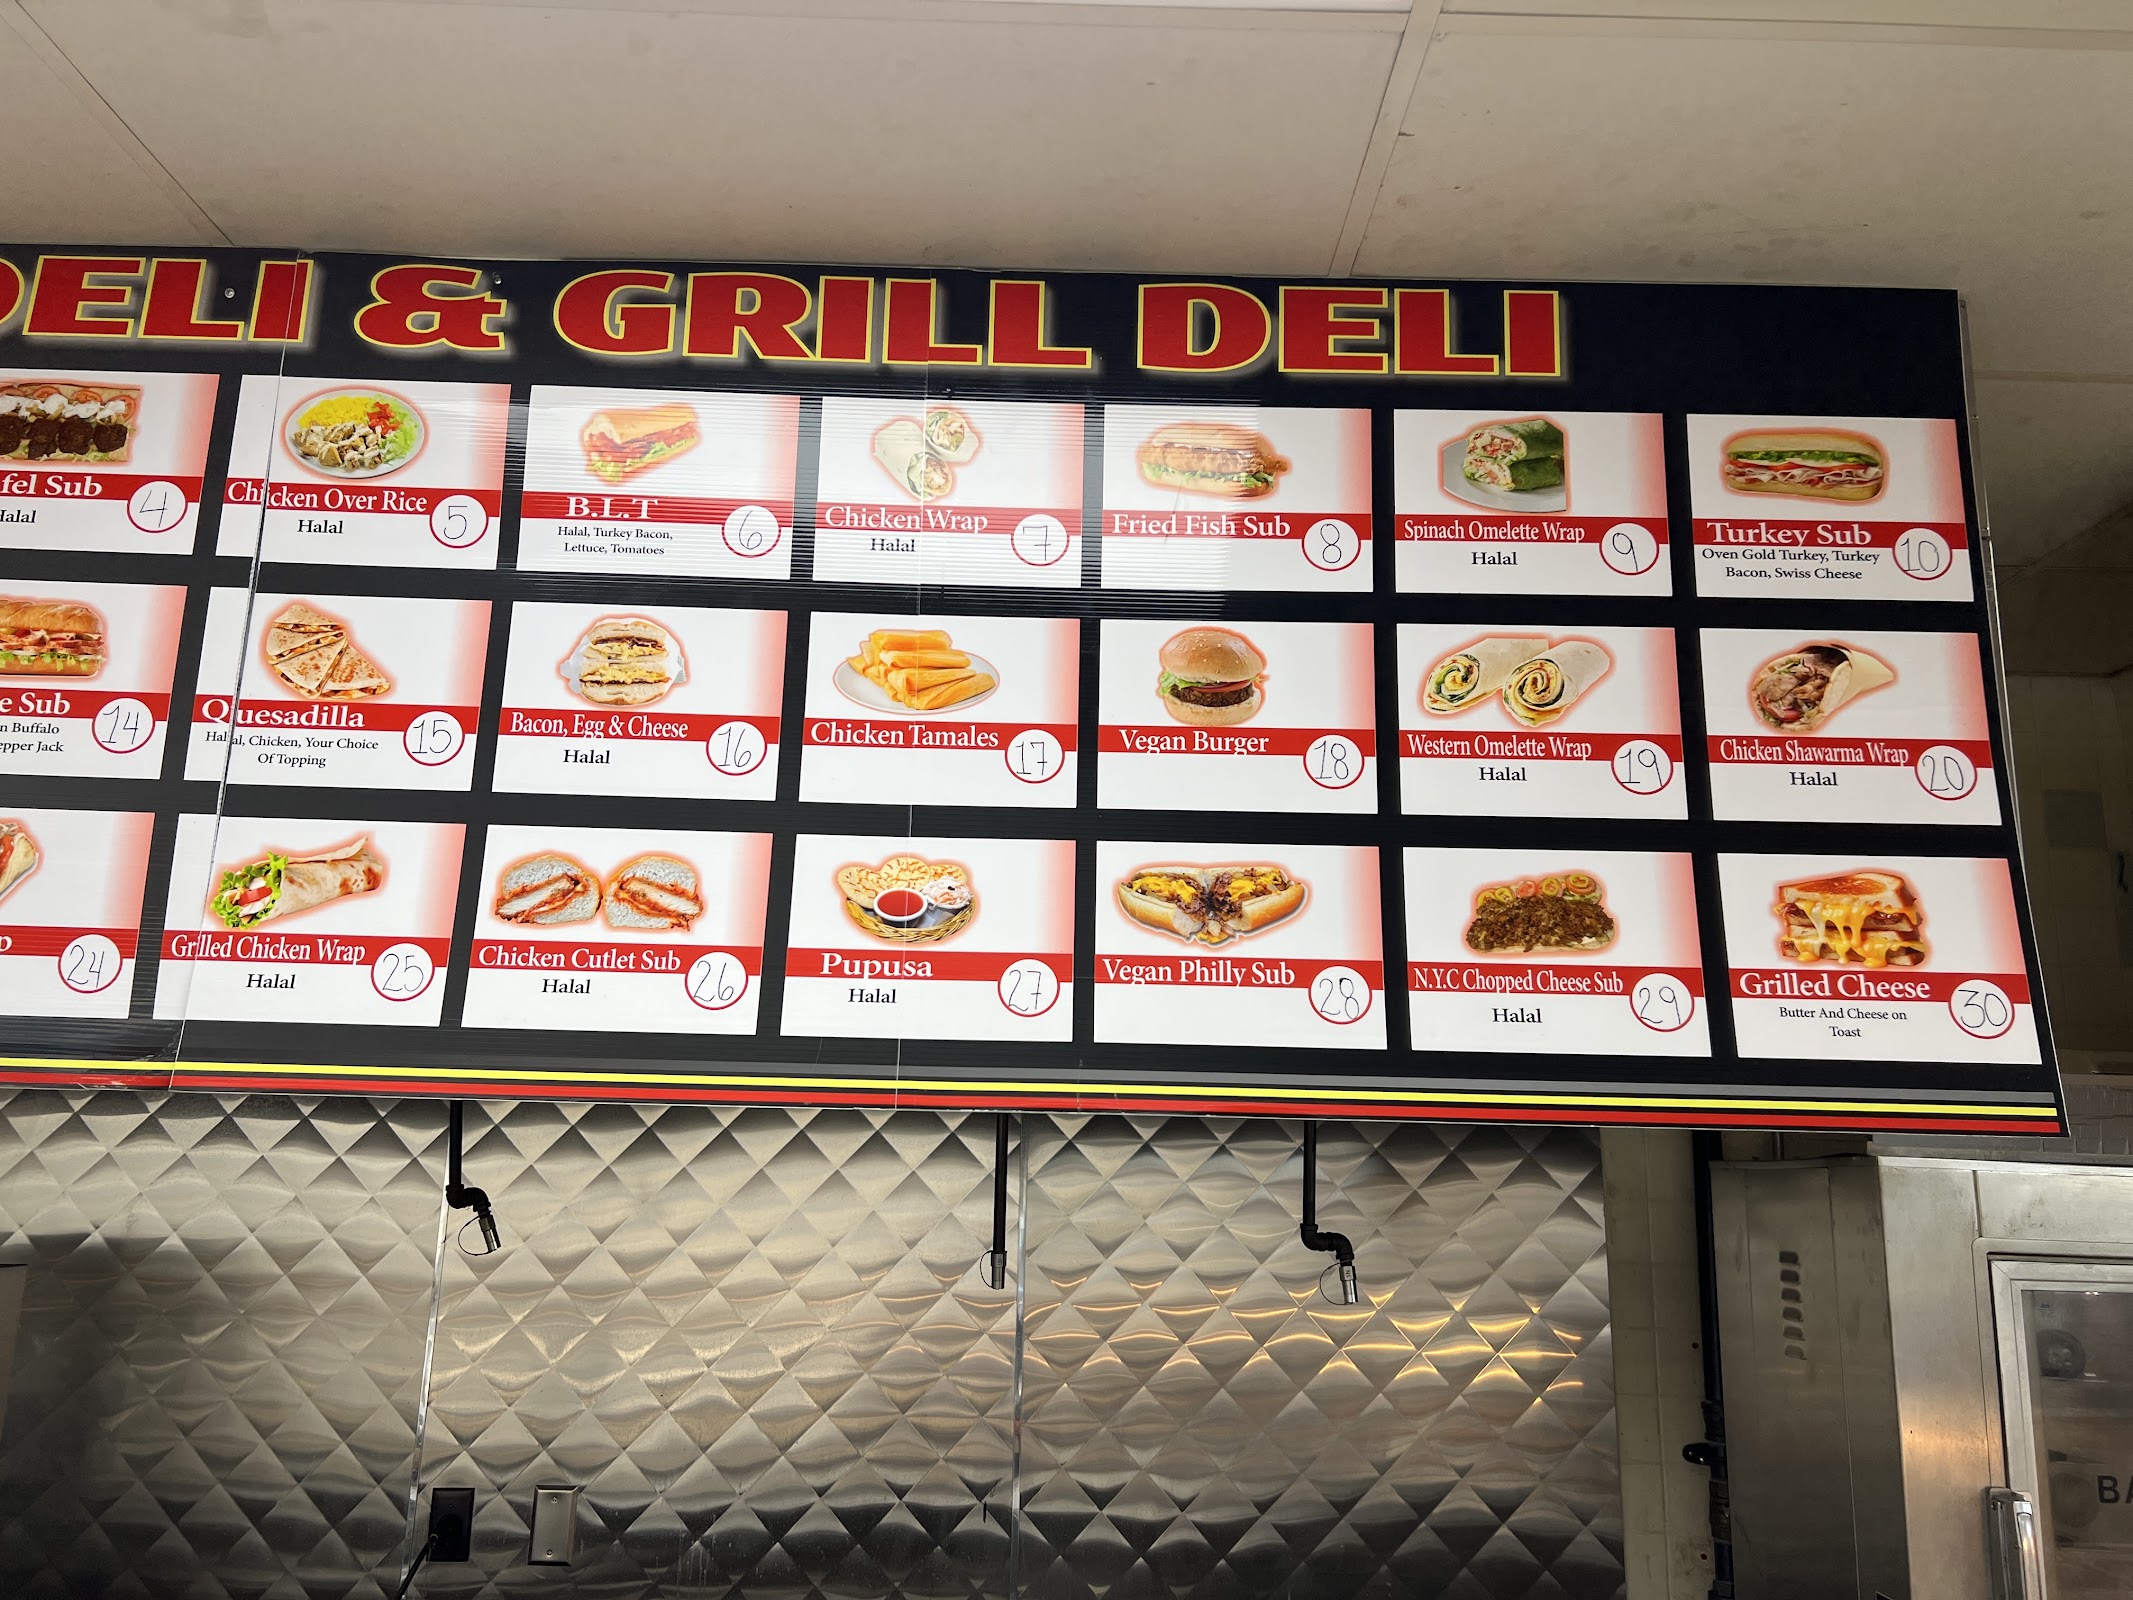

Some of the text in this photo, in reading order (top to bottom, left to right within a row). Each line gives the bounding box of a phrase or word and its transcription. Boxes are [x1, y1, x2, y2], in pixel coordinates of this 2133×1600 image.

[0, 255, 1561, 377] ELI & GRILL DELI
[44, 475, 103, 496] Sub
[228, 481, 427, 512] Chicken Over Rice
[140, 490, 168, 528] 4
[565, 496, 658, 519] B.L.T
[825, 506, 988, 533] Chicken Wrap
[297, 519, 344, 534] Halal
[443, 505, 470, 540] 5
[557, 526, 673, 541] Halal, Turkey Bacon,
[738, 510, 763, 550] 6
[1112, 514, 1291, 537] Fried Fish Sub
[1404, 520, 1585, 545] Spinach Omelette Wrap
[1706, 522, 1872, 547] Turkey Sub
[564, 543, 665, 555] Lettuce, Tomatoes
[870, 538, 915, 552] Halal
[1023, 525, 1051, 561] 7
[1320, 523, 1342, 564] 8
[1612, 532, 1639, 572] 9
[1902, 537, 1940, 573] 10
[1471, 551, 1518, 566] Halal
[1702, 548, 1880, 566] Oven Gold Turkey, Turkey
[1725, 566, 1862, 580] Bacon, Swiss Cheese
[18, 692, 71, 715] Sub
[202, 698, 365, 728] Quesadilla
[11, 722, 60, 734] Buffalo
[102, 705, 139, 745] 14
[411, 719, 452, 754] 15
[509, 711, 688, 739] Bacon, Egg & Cheese
[810, 722, 999, 748] Chicken Tamales
[36, 741, 64, 753] Jack
[205, 731, 379, 750] Halal, Chicken, Your Choice
[717, 726, 752, 769] 16
[1120, 729, 1269, 757] Vegan Burger
[1407, 734, 1592, 761] Western Omelette Wrap
[1720, 739, 1908, 766] Chicken Shawarma Wrap
[257, 753, 326, 768] Of Topping
[563, 749, 611, 764] Halal
[1015, 741, 1048, 776] 17
[1314, 739, 1349, 780] 18
[1619, 748, 1662, 787] 19
[1478, 767, 1527, 782] Halal
[1790, 771, 1838, 786] Halal
[1922, 755, 1965, 791] 20
[171, 934, 365, 965] Grilled Chicken Wrap
[478, 945, 681, 972] Chicken Cutlet Sub
[67, 944, 104, 988] 24
[382, 953, 424, 992] 25
[819, 952, 933, 980] Pupusa
[1102, 958, 1295, 988] Vegan Philly Sub
[246, 973, 296, 989] Halal
[541, 979, 591, 994] Halal
[693, 960, 734, 1003] 26
[1008, 968, 1042, 1012] 27
[1414, 968, 1623, 995] N.Y.C Chopped Cheese Sub
[1739, 972, 1930, 1000] Grilled Cheese
[848, 988, 897, 1004] Halal
[1320, 977, 1359, 1020] 28
[1640, 987, 1682, 1026] 29
[1958, 989, 2008, 1029] 30
[1492, 1007, 1542, 1024] Halal
[1780, 1007, 1907, 1021] Butter And Cheese on
[1829, 1026, 1861, 1038] Toast
[2097, 1475, 2133, 1504] B
